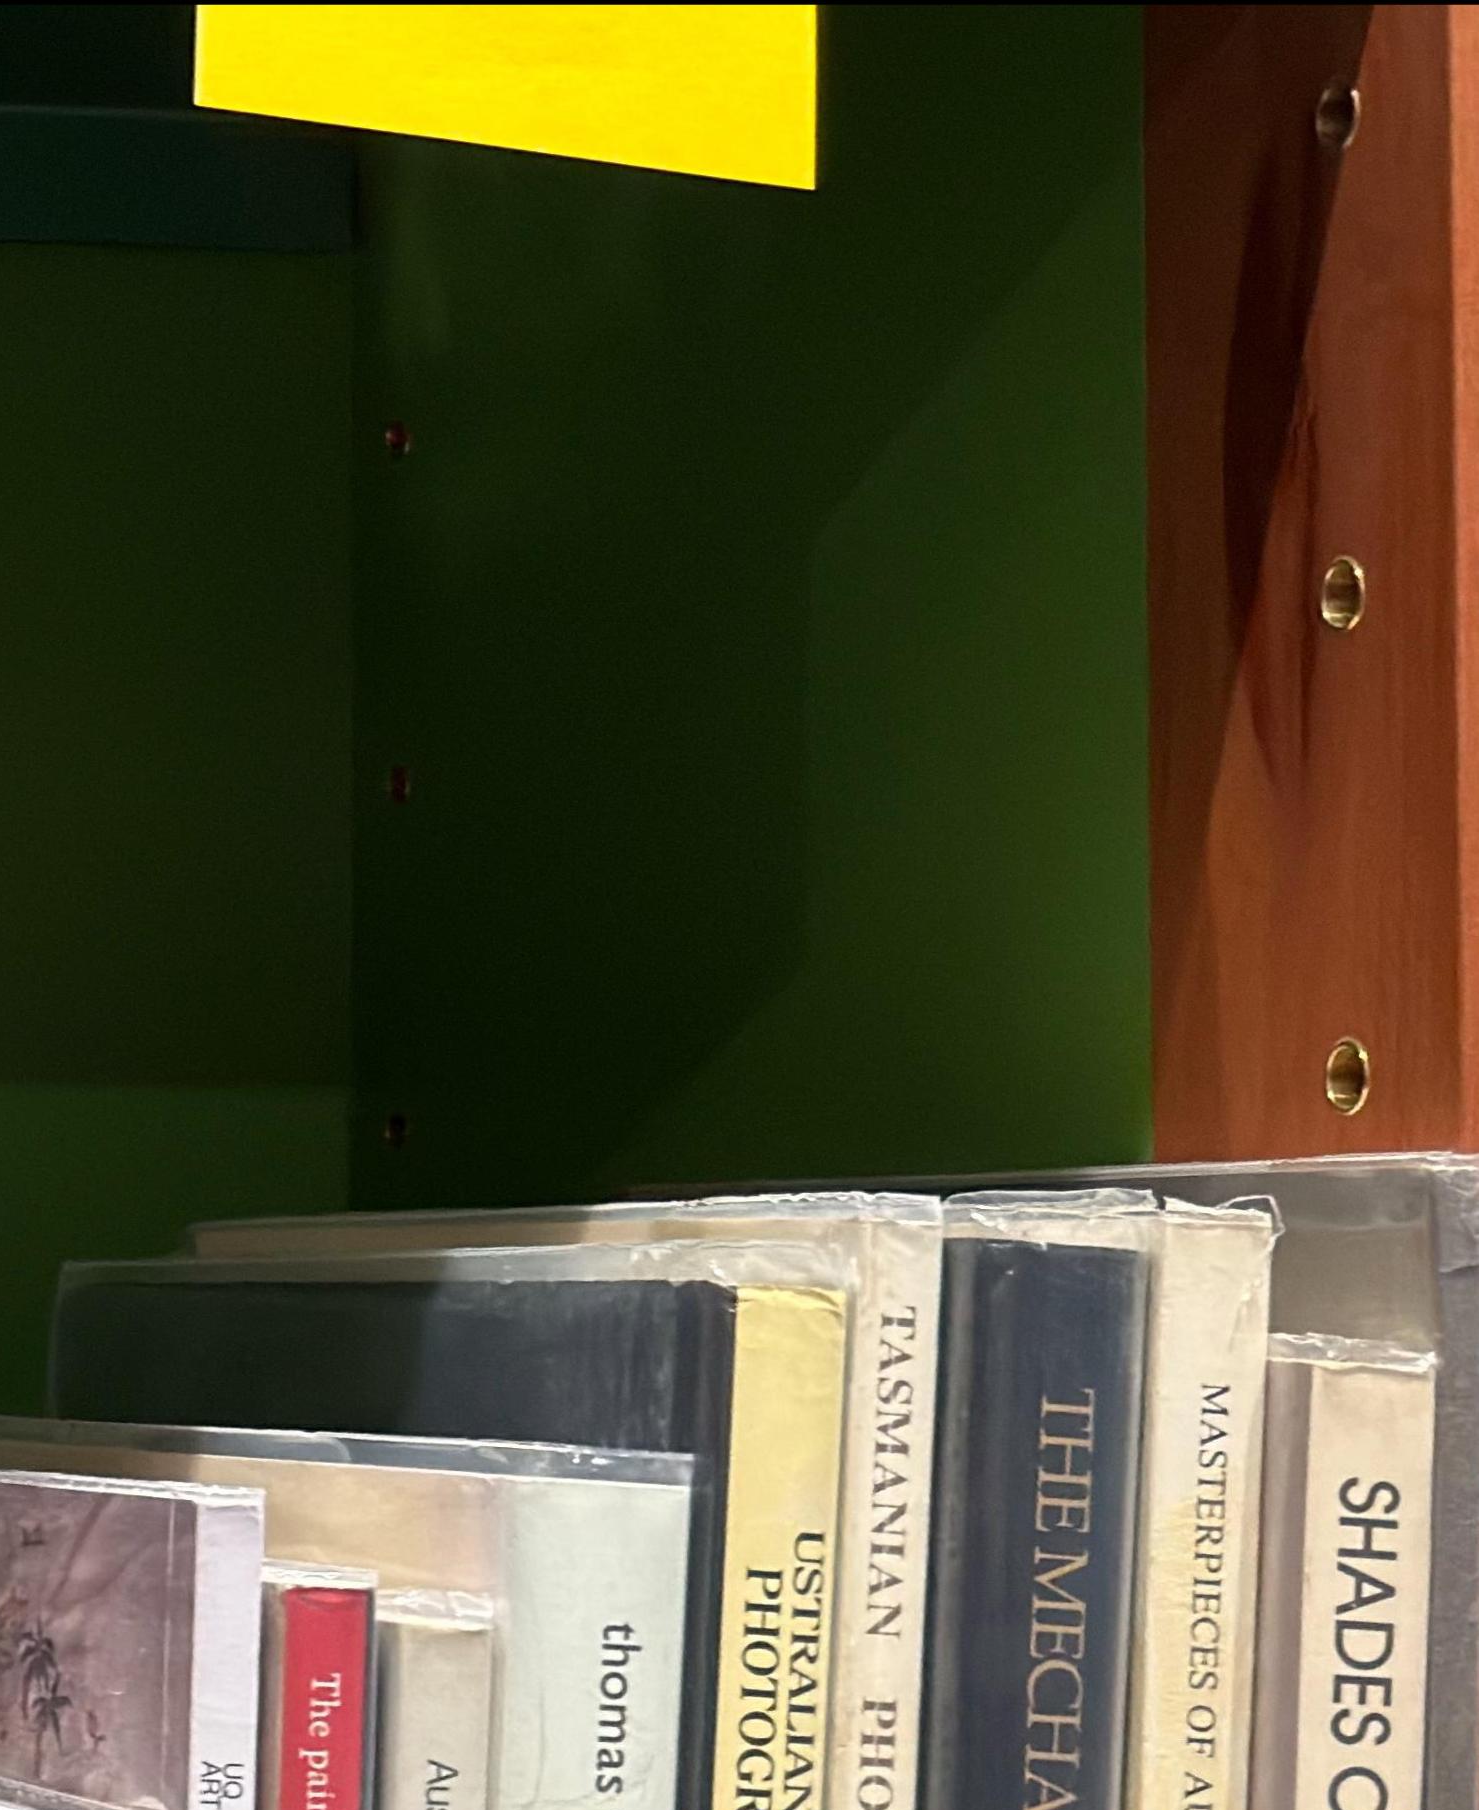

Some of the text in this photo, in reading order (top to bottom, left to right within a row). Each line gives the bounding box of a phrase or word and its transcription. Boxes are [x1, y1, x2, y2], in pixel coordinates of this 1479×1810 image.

[865, 1306, 916, 1638] TASMANIAN
[1036, 1388, 1095, 1532] THE
[1188, 1384, 1231, 1691] MASTERPIECES
[1331, 1477, 1400, 1746] SHADES
[197, 1762, 222, 1803] ART
[307, 1673, 340, 1738] The
[600, 1623, 643, 1795] thomas
[1186, 1705, 1217, 1757] OF
